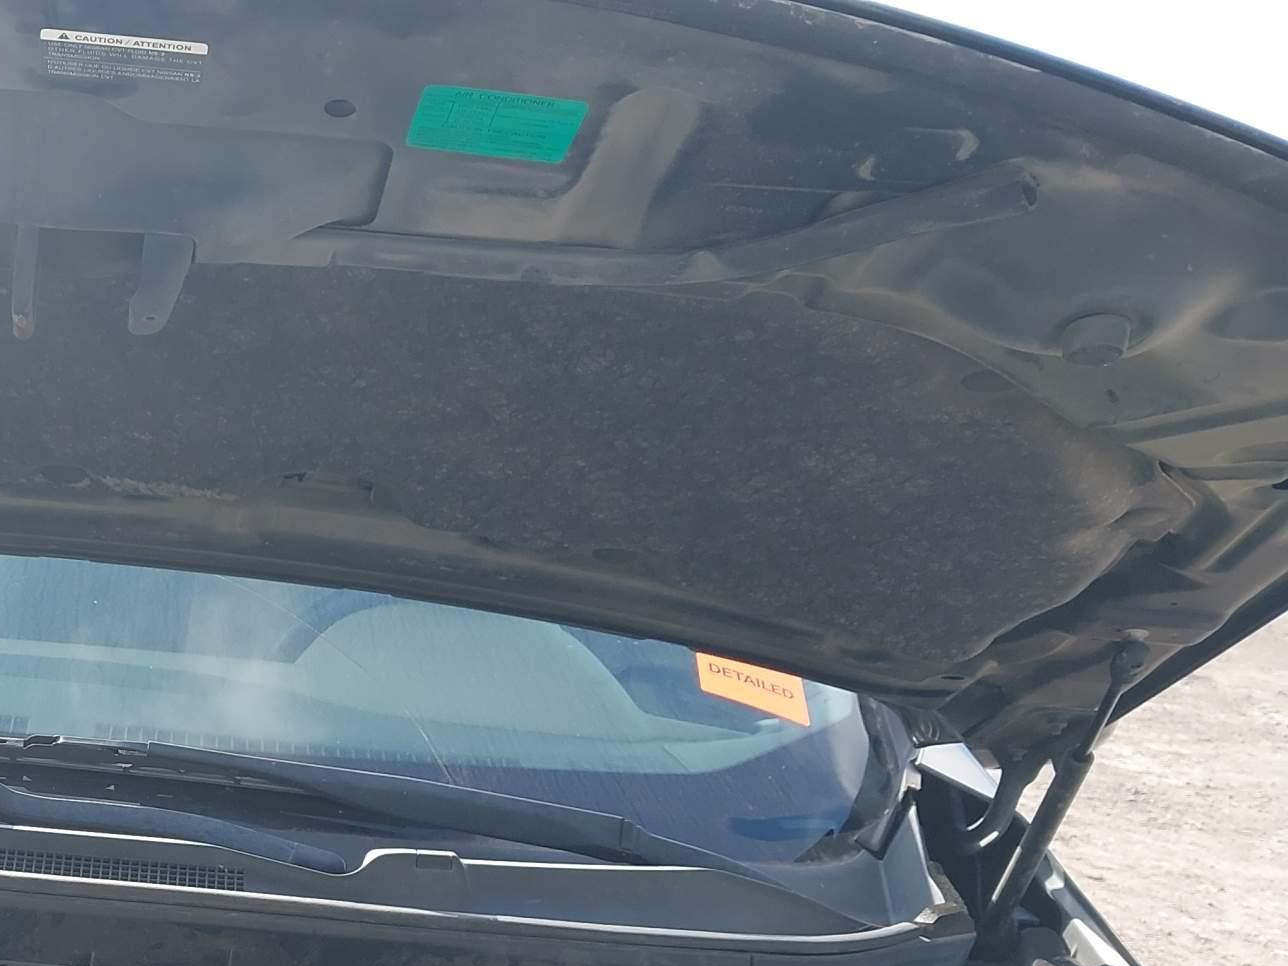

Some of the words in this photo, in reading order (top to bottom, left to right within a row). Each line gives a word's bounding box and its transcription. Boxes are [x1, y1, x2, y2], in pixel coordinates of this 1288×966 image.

[74, 35, 123, 45] CAUTION
[133, 40, 192, 52] ATTENTION
[709, 663, 794, 699] DETAILED
